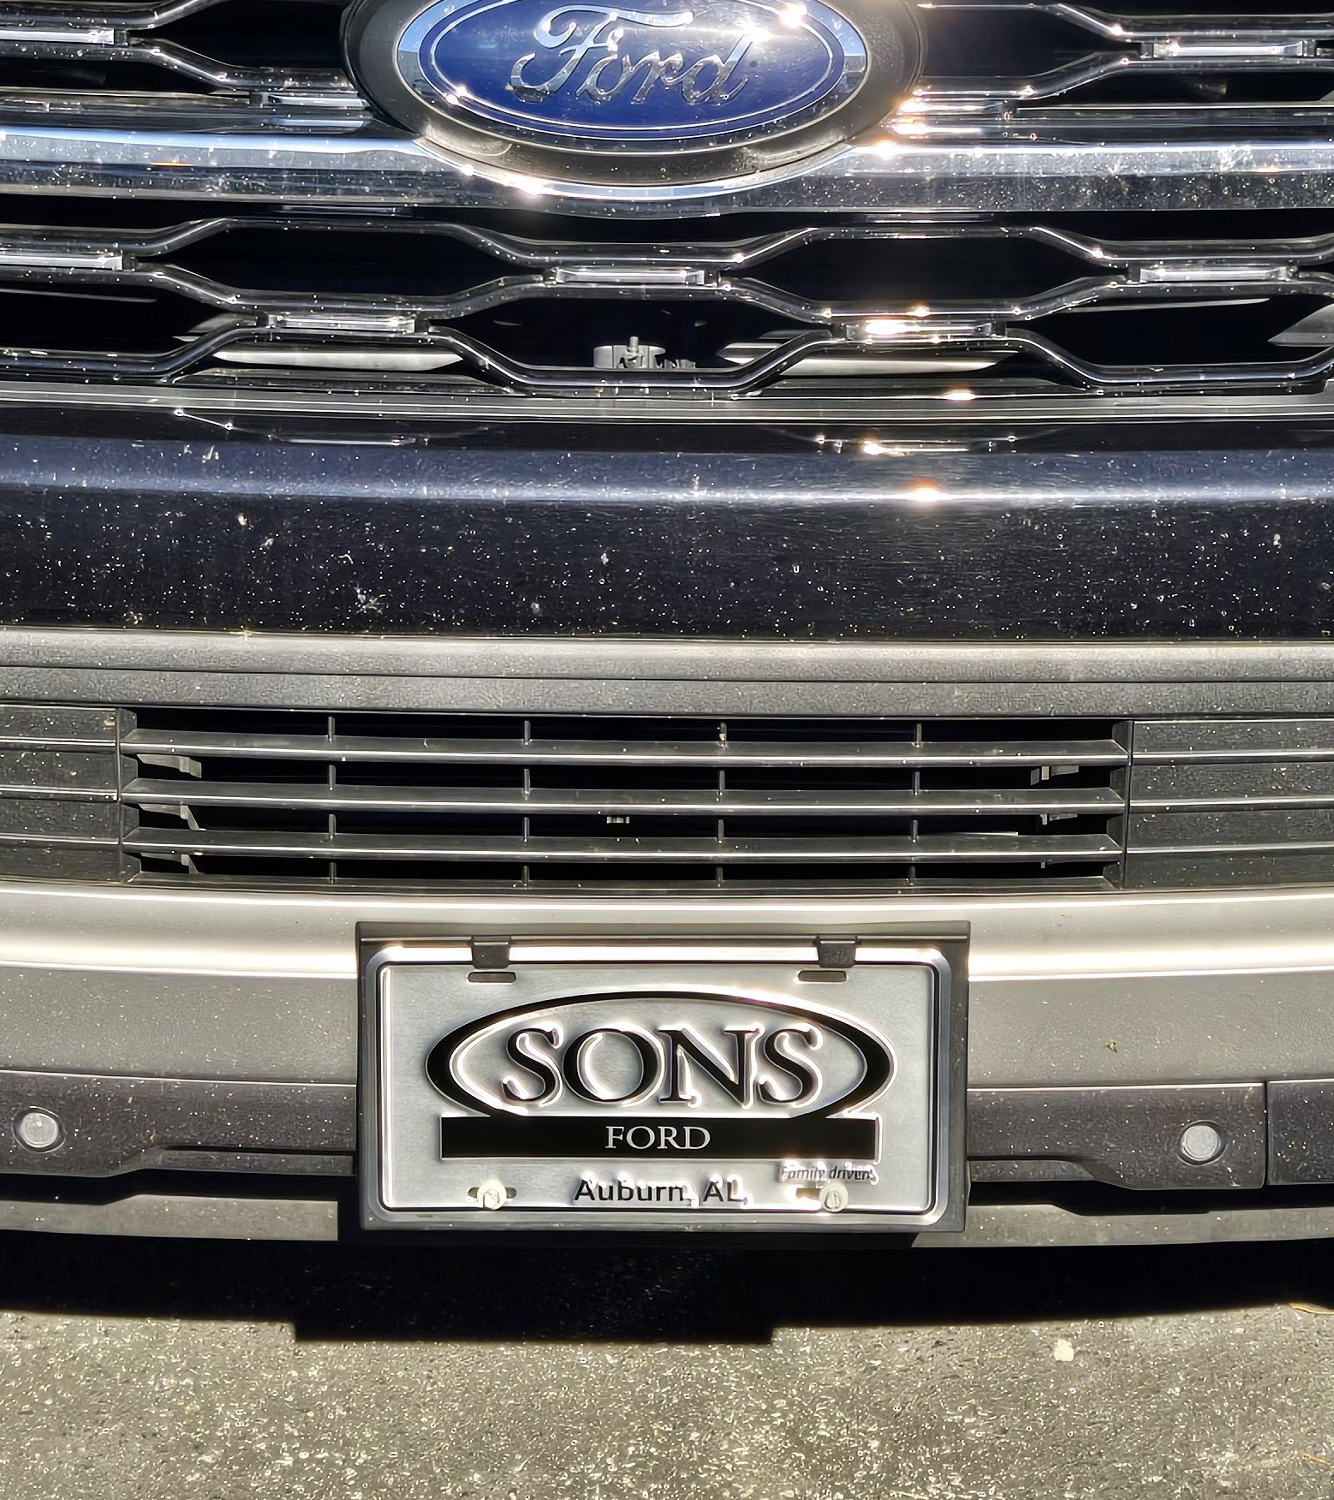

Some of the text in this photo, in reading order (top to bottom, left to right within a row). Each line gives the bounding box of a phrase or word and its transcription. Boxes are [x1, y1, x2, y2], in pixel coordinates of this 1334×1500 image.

[508, 3, 753, 104] Ford
[502, 1026, 822, 1104] SONS
[605, 1125, 711, 1151] FORD
